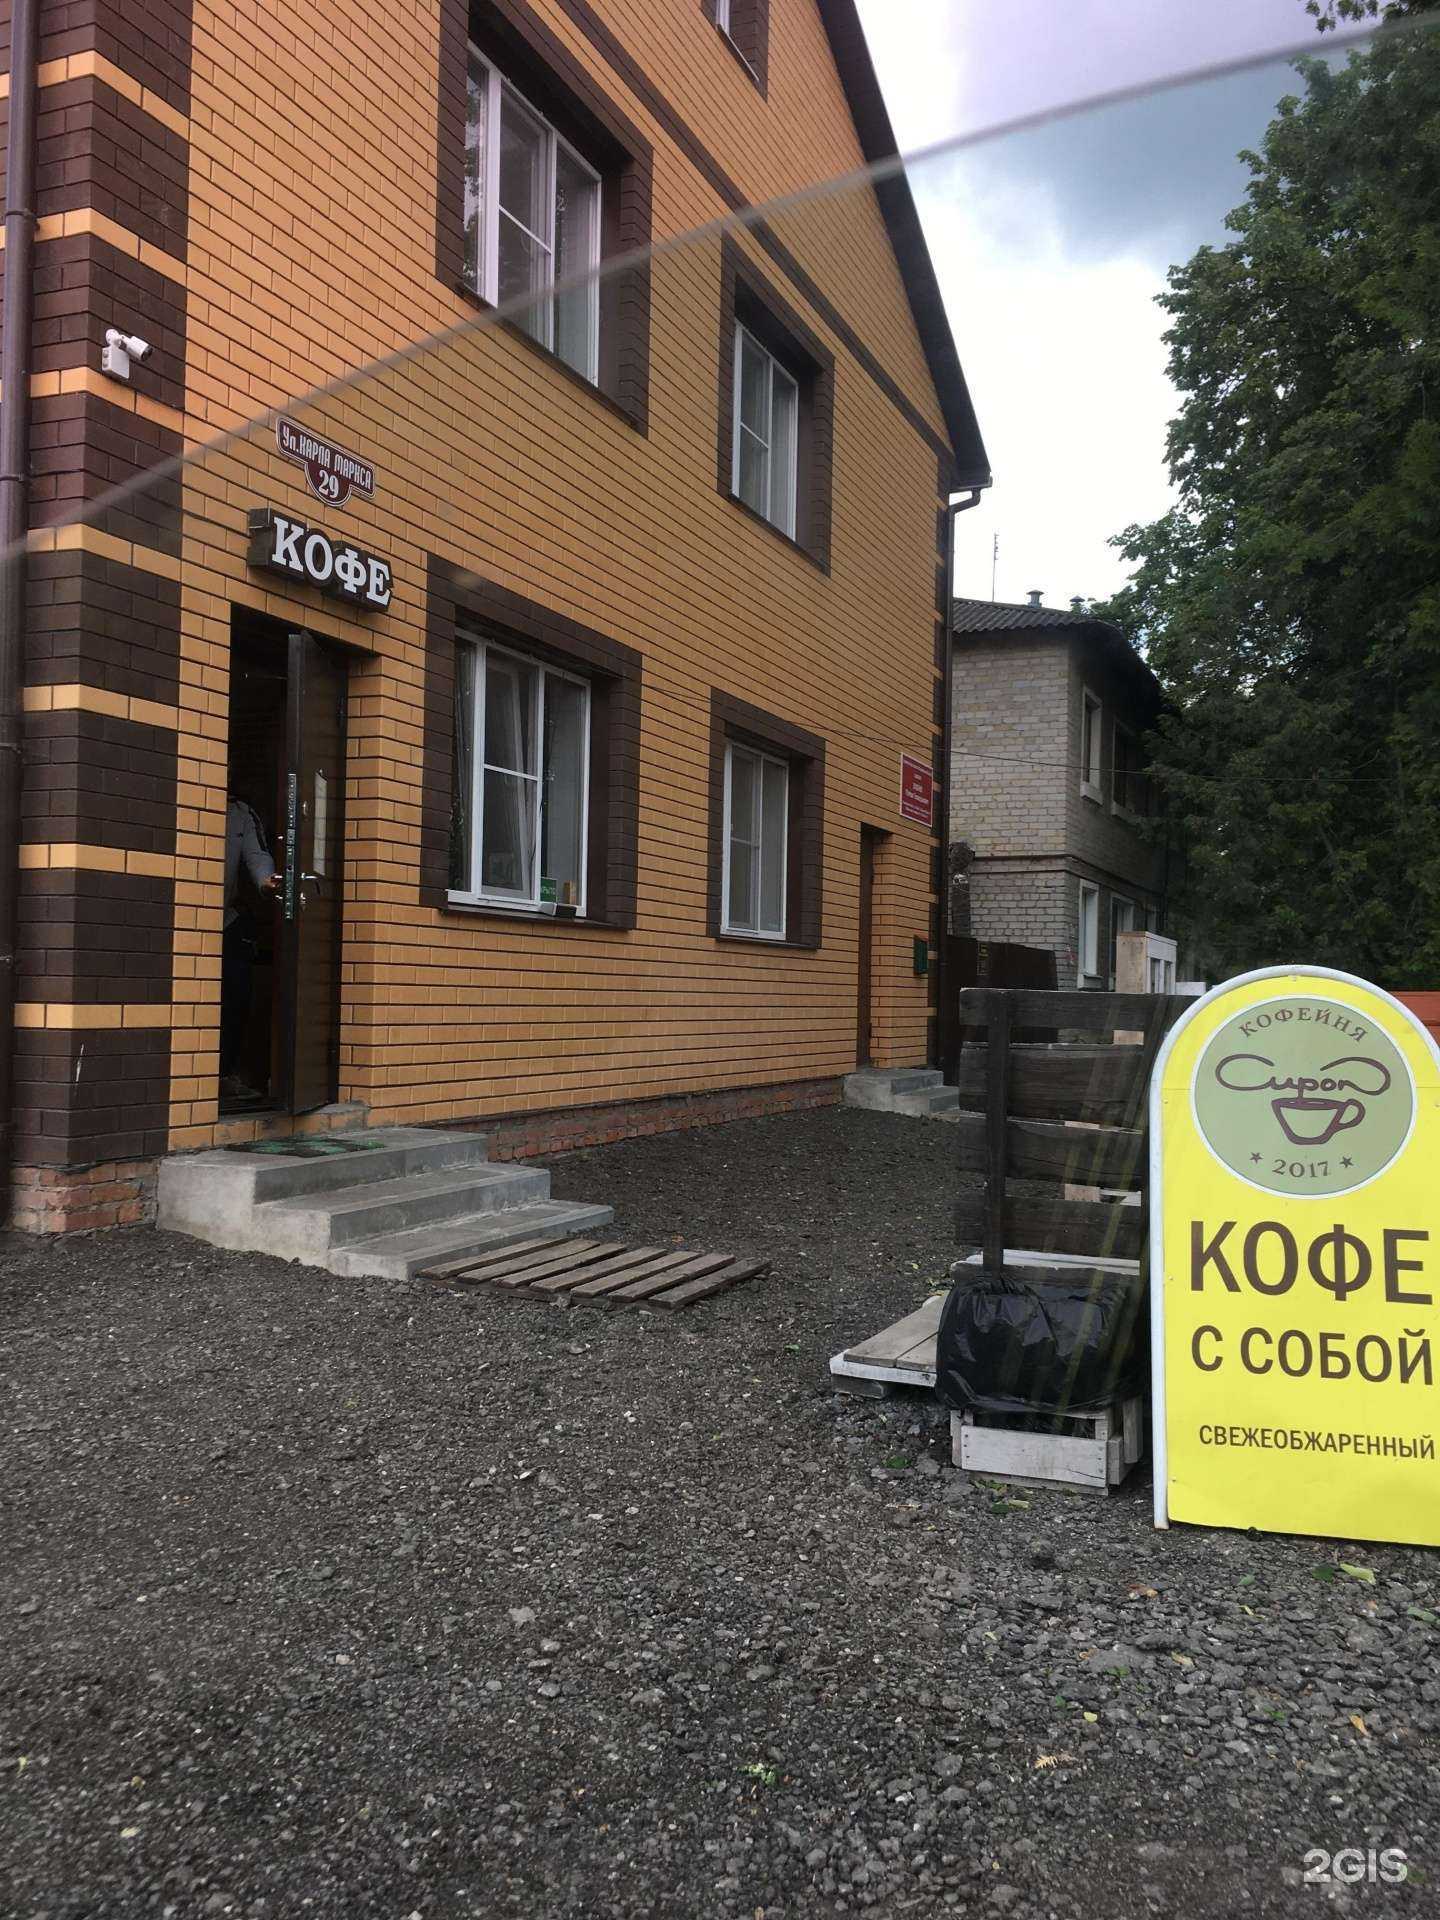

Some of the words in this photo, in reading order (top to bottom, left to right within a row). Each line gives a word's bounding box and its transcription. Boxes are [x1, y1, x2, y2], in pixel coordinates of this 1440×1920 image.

[318, 469, 340, 499] 29
[334, 454, 372, 490] МАРКСА
[271, 516, 392, 606] КОФЕ
[1238, 1006, 1369, 1042] КОФЕЙНЯ
[1215, 1053, 1392, 1099] Сироп
[1271, 1158, 1332, 1178] 2017
[1190, 1220, 1434, 1306] КОФЕ
[1191, 1324, 1224, 1372] С
[1240, 1328, 1434, 1386] СОБОЙ
[1199, 1424, 1436, 1460] СВЕЖЕОБЖАРЕННЫЙ
